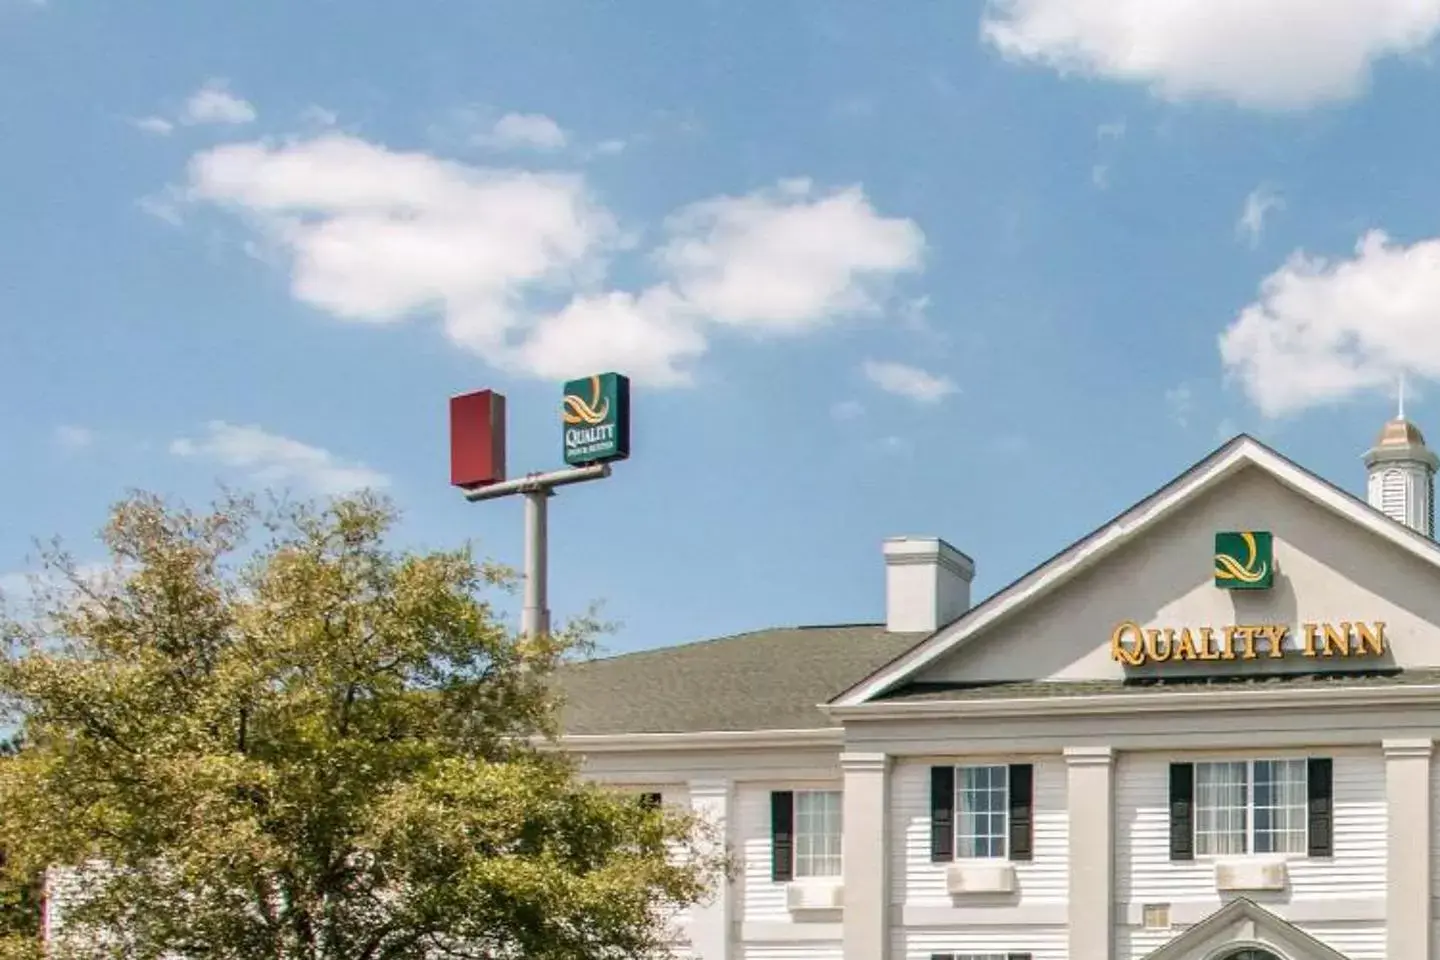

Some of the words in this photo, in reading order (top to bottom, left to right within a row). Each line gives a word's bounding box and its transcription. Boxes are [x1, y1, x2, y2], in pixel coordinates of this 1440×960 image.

[566, 424, 615, 448] QUALITY
[1111, 620, 1289, 666] QUALITY
[1302, 621, 1387, 656] INN
